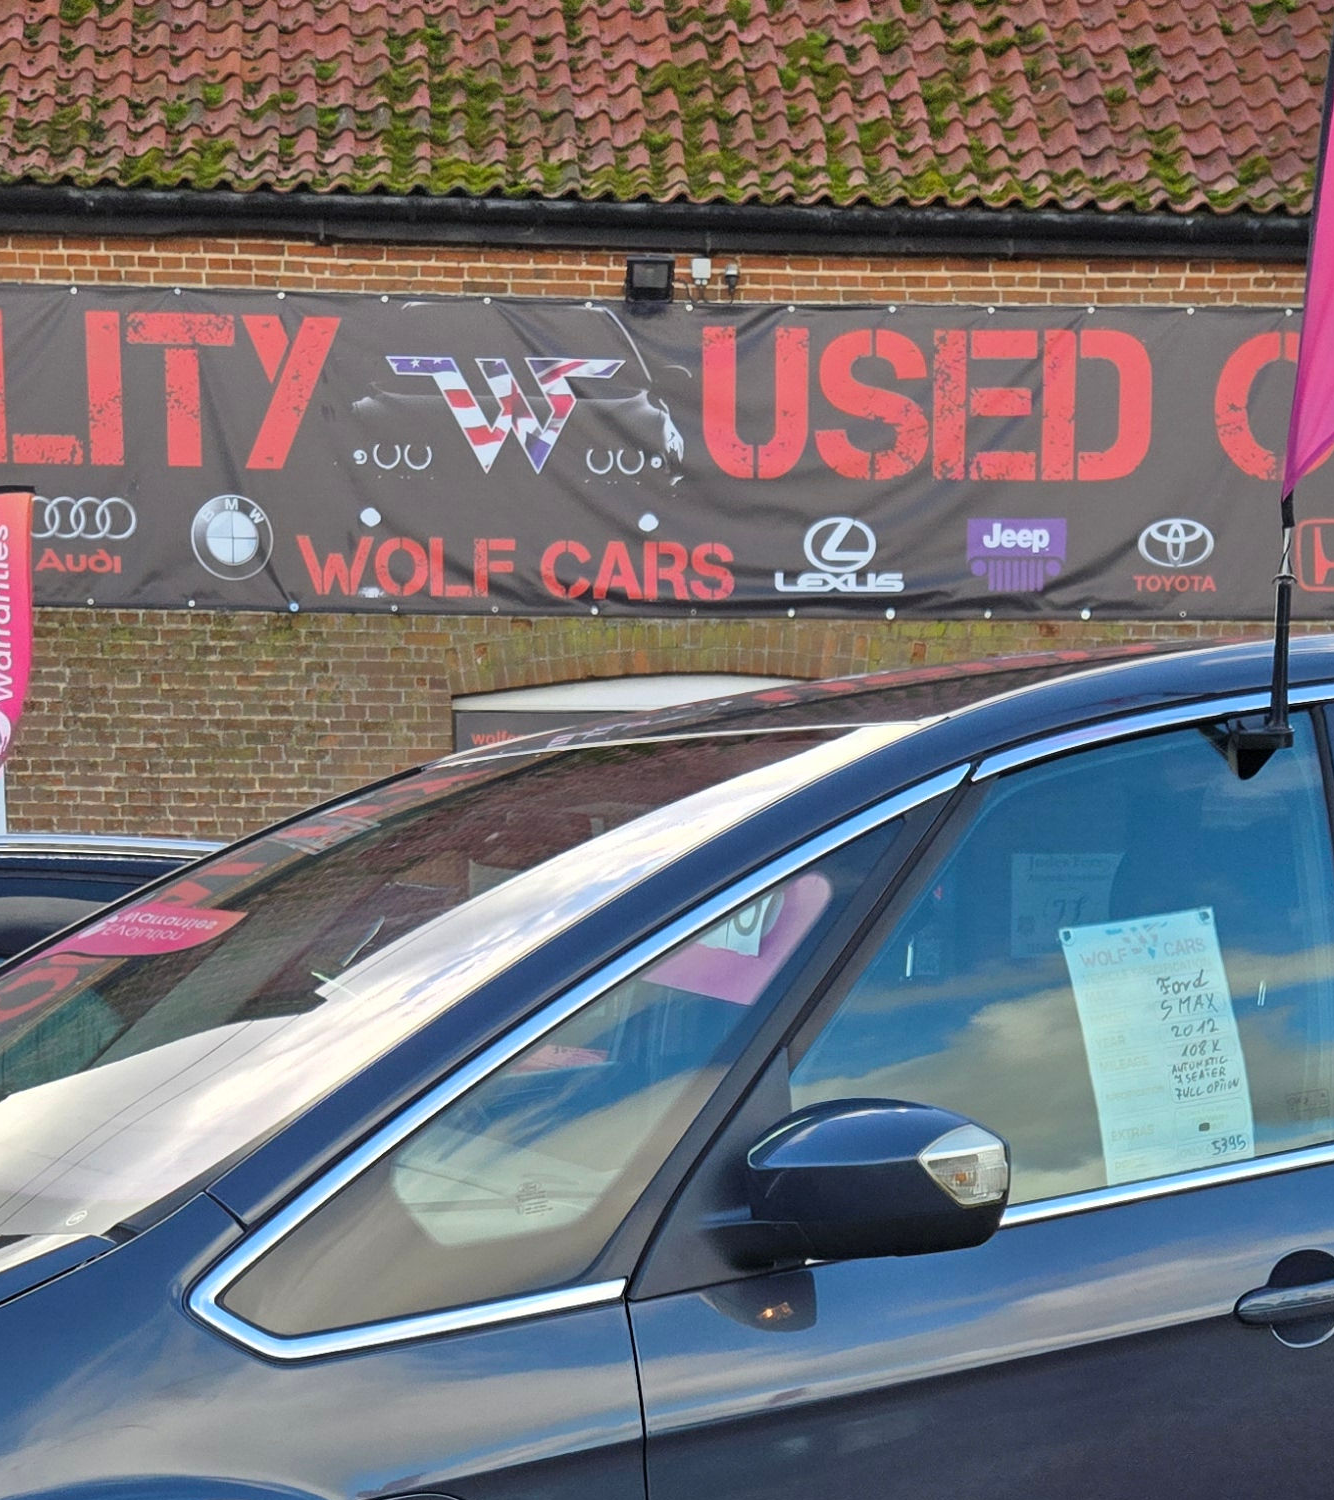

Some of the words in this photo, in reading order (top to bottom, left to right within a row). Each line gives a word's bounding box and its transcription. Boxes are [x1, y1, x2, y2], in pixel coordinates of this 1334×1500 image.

[703, 326, 1153, 482] USED
[201, 498, 265, 524] BMW
[982, 522, 1050, 554] Jeep
[34, 547, 122, 575] Audi
[296, 535, 516, 598] WOLF
[541, 540, 735, 601] CARS
[774, 571, 905, 594] LEXUS
[1133, 575, 1217, 594] TOYOTA
[1079, 948, 1127, 968] WOLF
[1164, 937, 1206, 957] CARS
[1156, 968, 1210, 996] Ford
[1178, 993, 1219, 1015] MAX
[1171, 1018, 1219, 1038] 2012
[1181, 1041, 1207, 1058] 108
